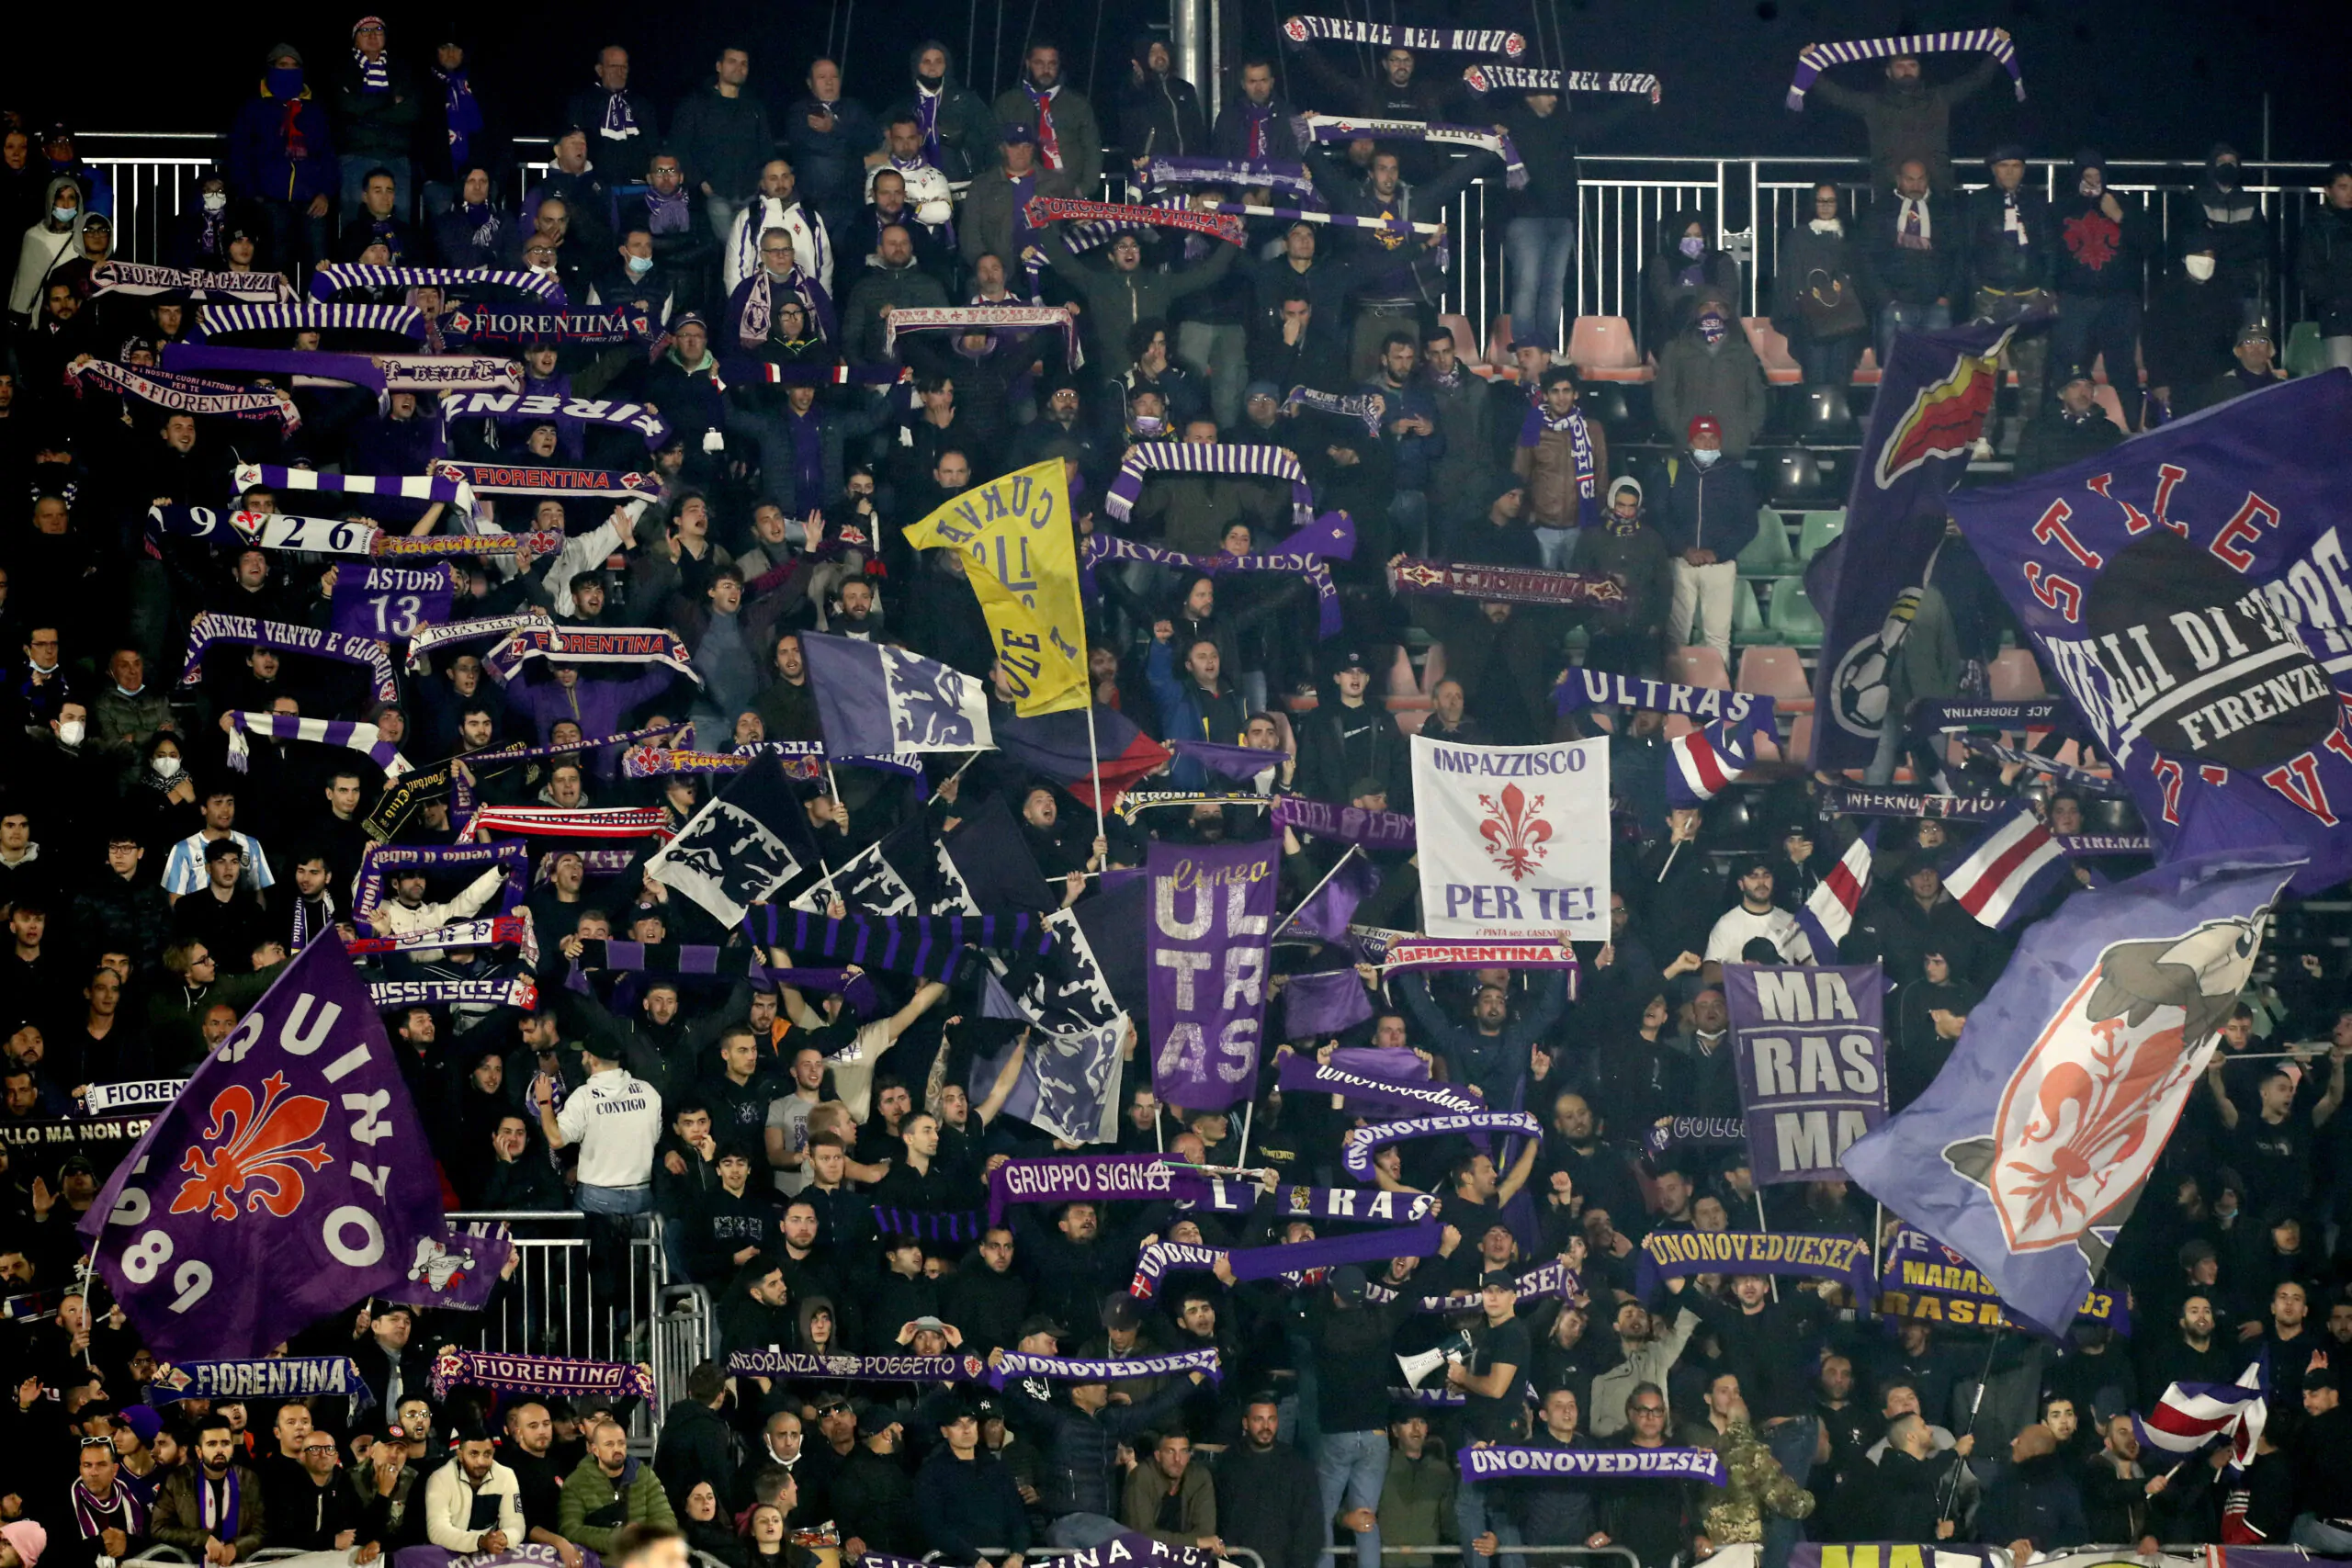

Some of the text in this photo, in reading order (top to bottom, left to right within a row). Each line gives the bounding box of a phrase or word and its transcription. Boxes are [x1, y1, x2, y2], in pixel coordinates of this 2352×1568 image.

[1306, 15, 1505, 52] FIRENZE NEL NORD
[1485, 64, 1560, 88] FIRENZE
[1569, 71, 1600, 90] NEL
[1160, 209, 1219, 230] VIOLA
[120, 266, 275, 292] FORZA RAGAZZI
[474, 313, 629, 334] FIORENTINA
[148, 384, 275, 412] FIORENTINA
[171, 381, 187, 390] PER
[475, 468, 610, 489] FIORENTINA
[190, 506, 217, 537] 9
[278, 516, 306, 548] 2
[328, 522, 355, 551] 6
[364, 567, 445, 592] ASTORI
[369, 595, 422, 637] 13
[263, 621, 322, 649] VANTO
[325, 631, 340, 651] E
[535, 633, 663, 654] FORENTINA
[2169, 605, 2249, 671] DI
[1582, 669, 1754, 721] ULTRAS
[2177, 663, 2330, 750] FIRENZE
[1942, 706, 2052, 718] ACF FIORENTINA
[1433, 747, 1587, 777] IMPAZZISCO
[591, 811, 659, 825] MADRID
[1367, 808, 1416, 840] CAM
[1445, 883, 1597, 921] PER TE!
[1753, 971, 1859, 1022] MA
[1752, 1034, 1880, 1096] RAS
[596, 1098, 647, 1116] CONTIGO
[46, 1125, 75, 1143] MA
[80, 1122, 122, 1140] NON
[1005, 1161, 1091, 1194] GRUPPO
[1653, 1233, 1860, 1272] UNONOVEDUESEI
[196, 1358, 346, 1394] FIORENTINA
[477, 1359, 621, 1383] FIORENTINA
[865, 1355, 956, 1375] POGGETTO
[1470, 1450, 1720, 1477] UNONOVEDUESEI
